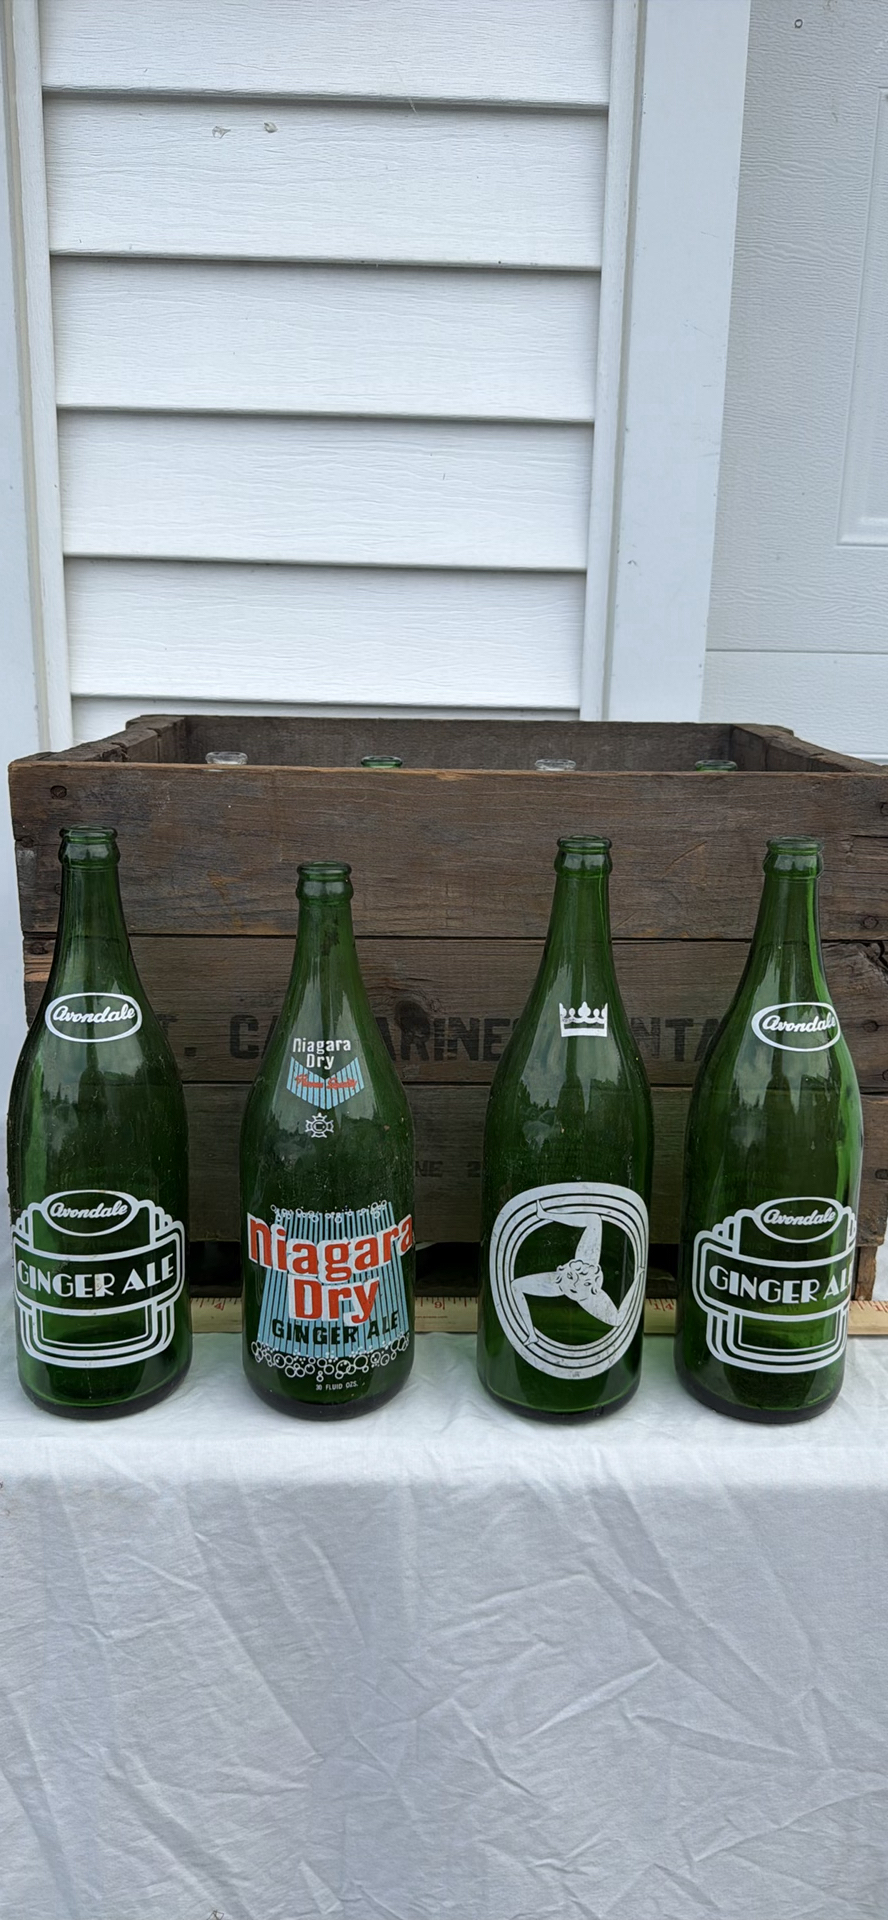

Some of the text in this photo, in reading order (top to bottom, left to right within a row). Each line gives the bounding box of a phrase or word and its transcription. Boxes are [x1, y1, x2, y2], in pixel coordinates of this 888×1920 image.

[53, 1003, 136, 1024] Avondale
[762, 1012, 836, 1032] Avondale
[306, 1053, 335, 1070] Dry
[49, 1200, 129, 1219] Avondale
[763, 1207, 836, 1226] Avondale
[16, 1252, 175, 1299] GINGER ALE
[709, 1264, 820, 1304] GINGER
[288, 1275, 380, 1327] Dry
[271, 1311, 399, 1346] GINGER ALE
